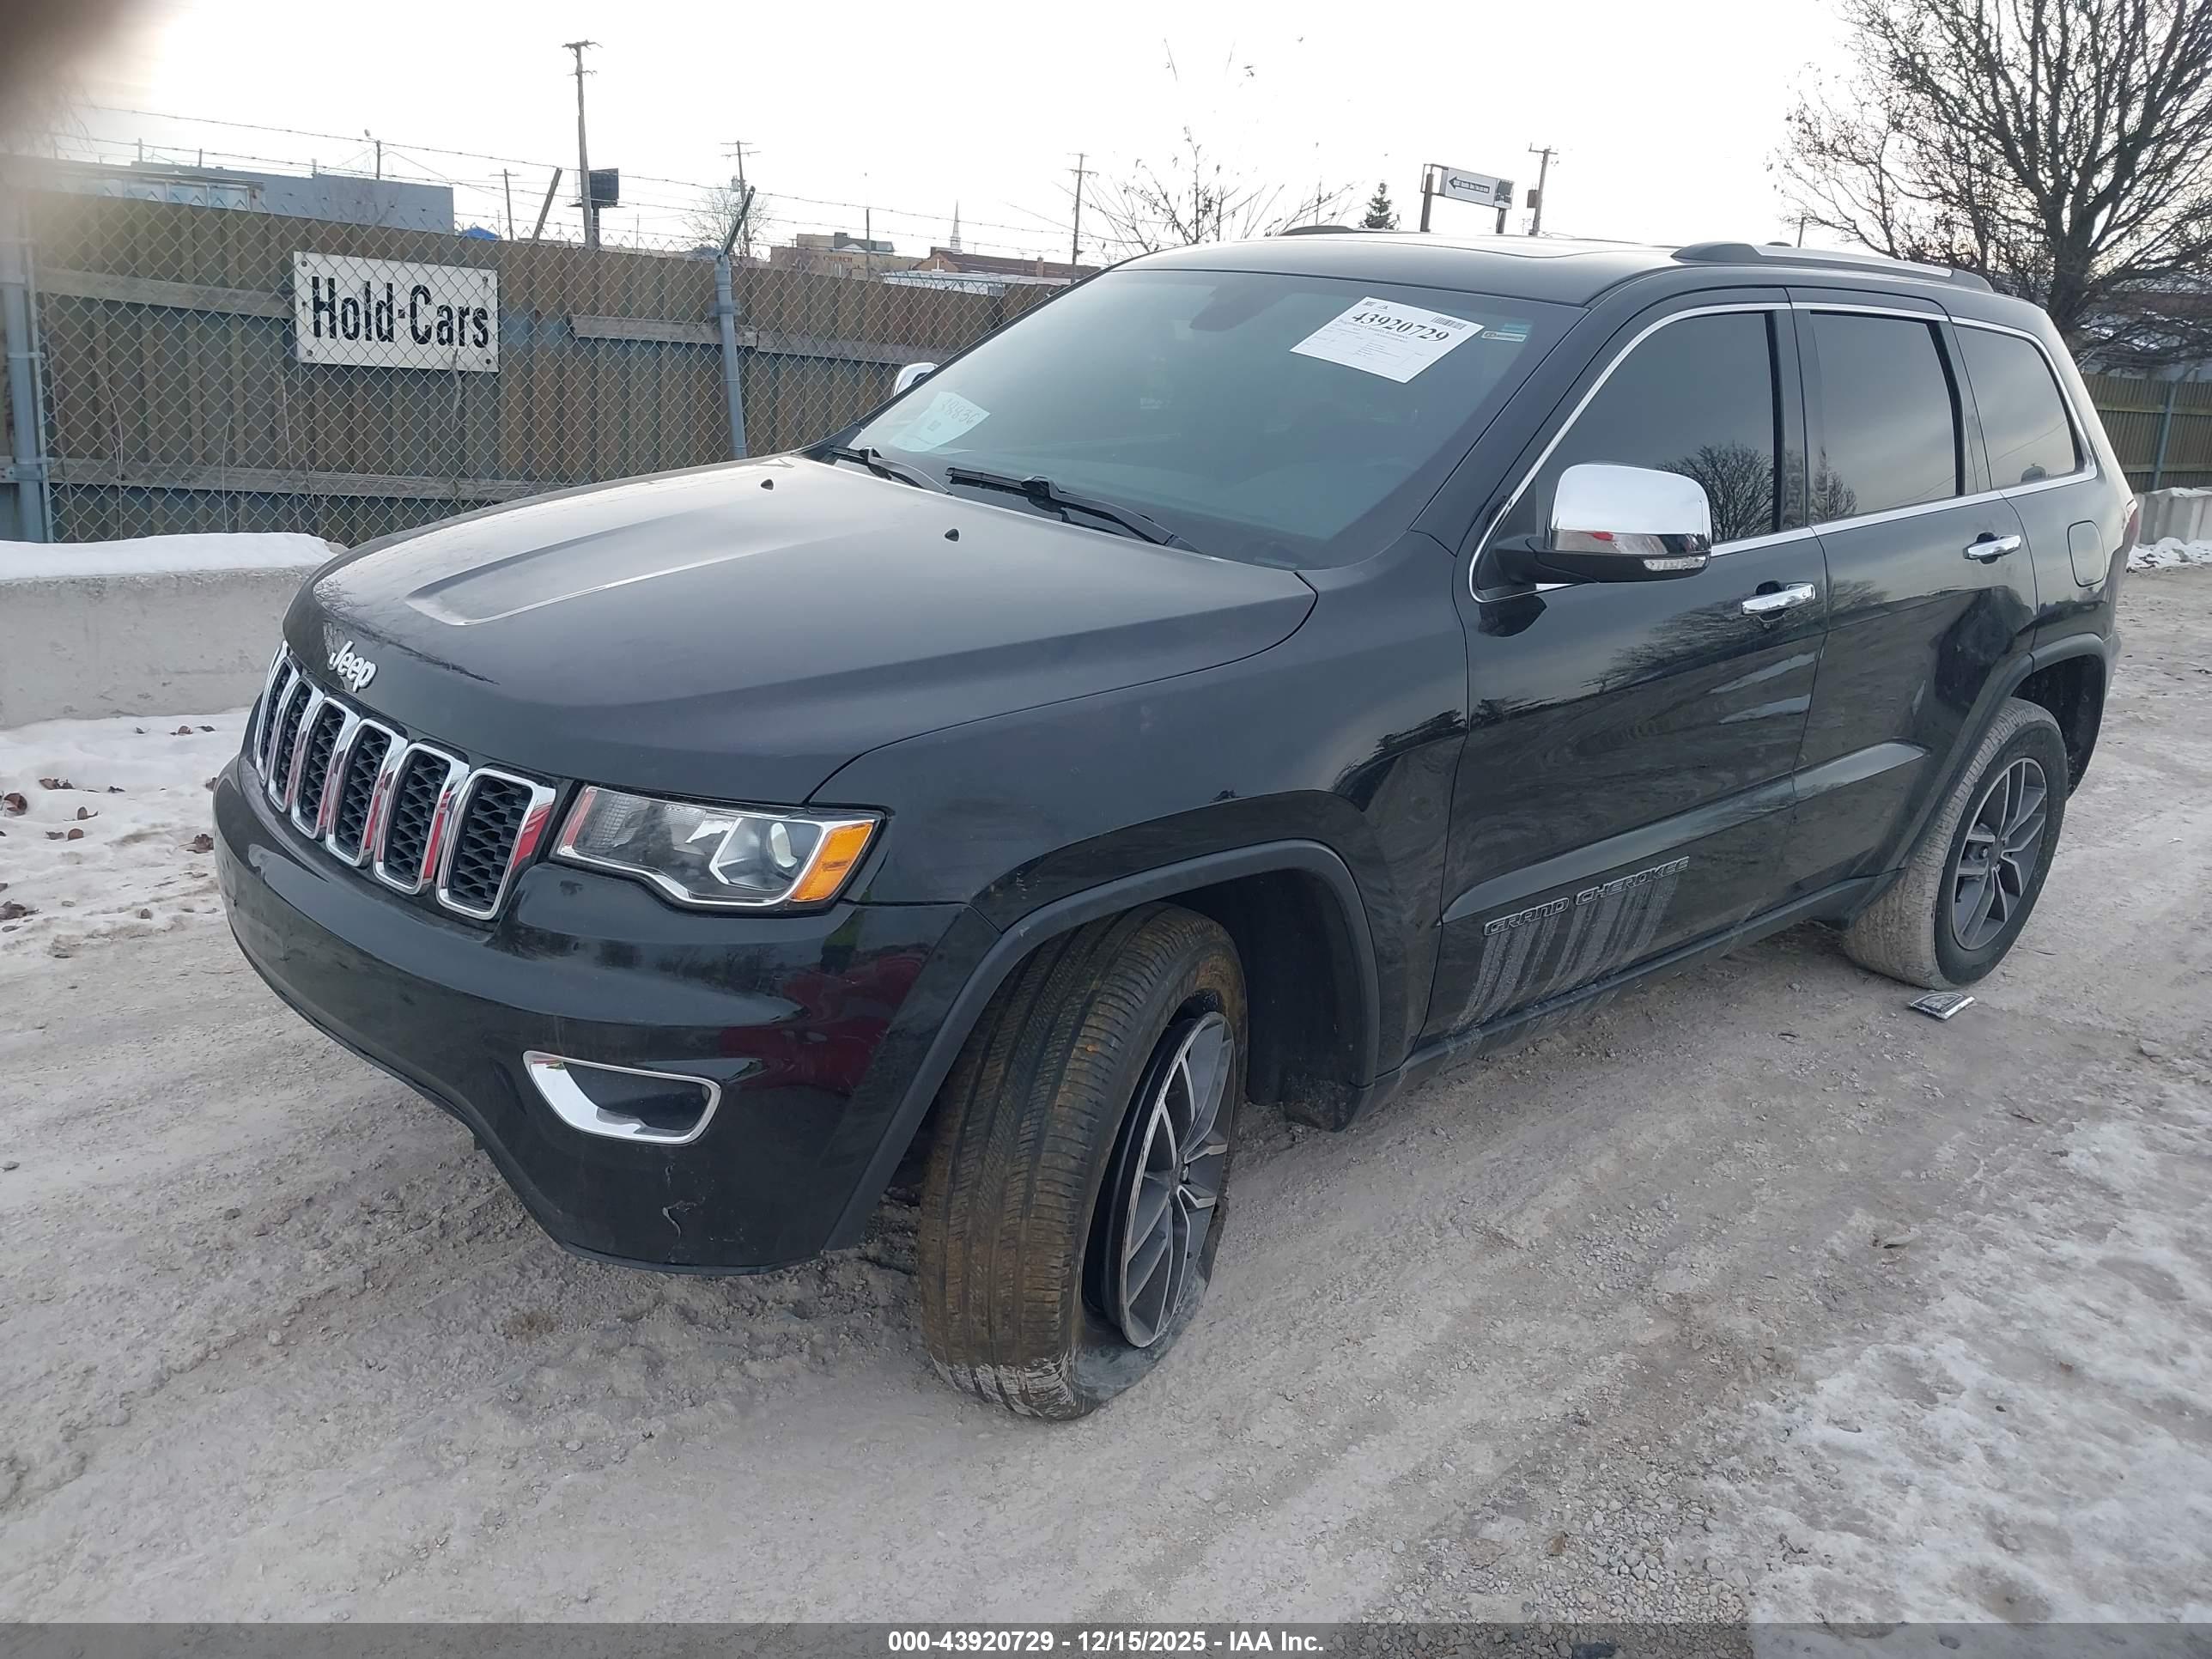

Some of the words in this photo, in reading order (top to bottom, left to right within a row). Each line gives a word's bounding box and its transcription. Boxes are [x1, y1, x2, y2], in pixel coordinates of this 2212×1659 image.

[312, 276, 489, 349] Hold-Cars
[1352, 312, 1450, 343] 43920729
[328, 640, 378, 693] Jeep
[1484, 897, 1570, 936] GRAND
[1575, 855, 1690, 906] CHEROKEE
